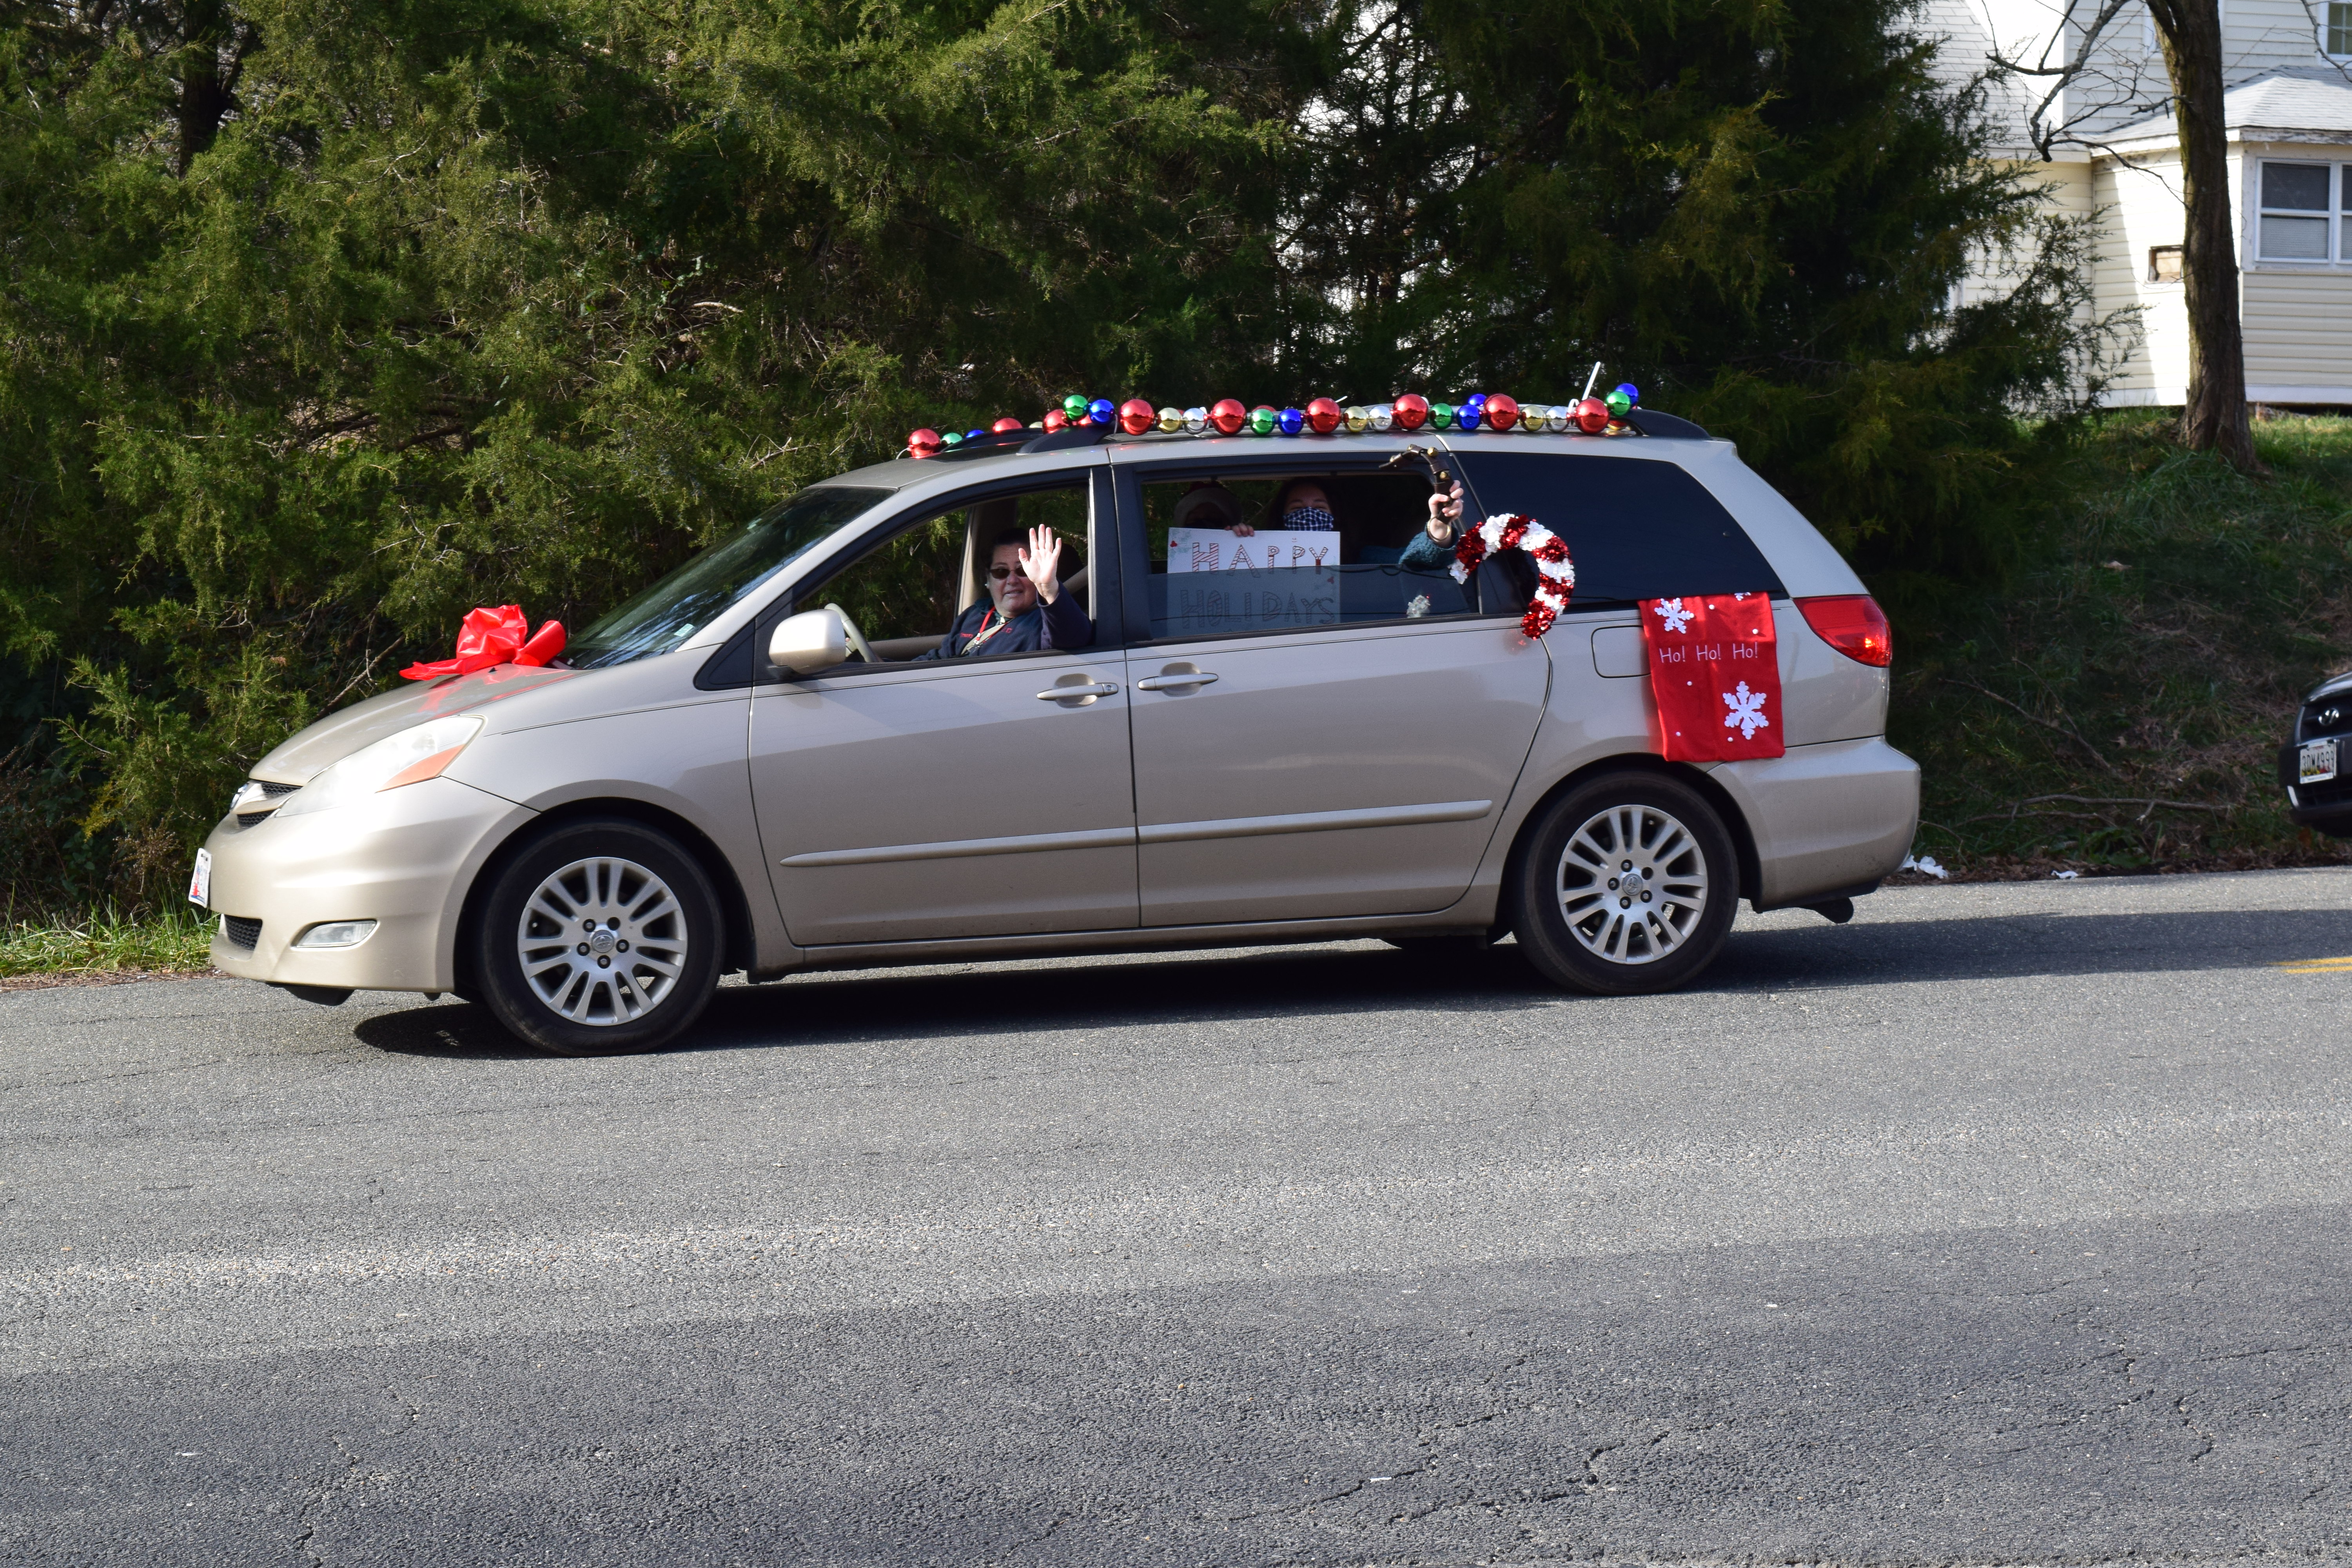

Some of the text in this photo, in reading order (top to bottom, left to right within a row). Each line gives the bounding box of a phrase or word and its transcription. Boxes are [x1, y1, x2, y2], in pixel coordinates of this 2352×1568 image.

[1192, 542, 1328, 577] HAPPY
[1180, 590, 1335, 629] HOLIDAYS
[1659, 641, 1758, 663] Ho! Ho! Ho!
